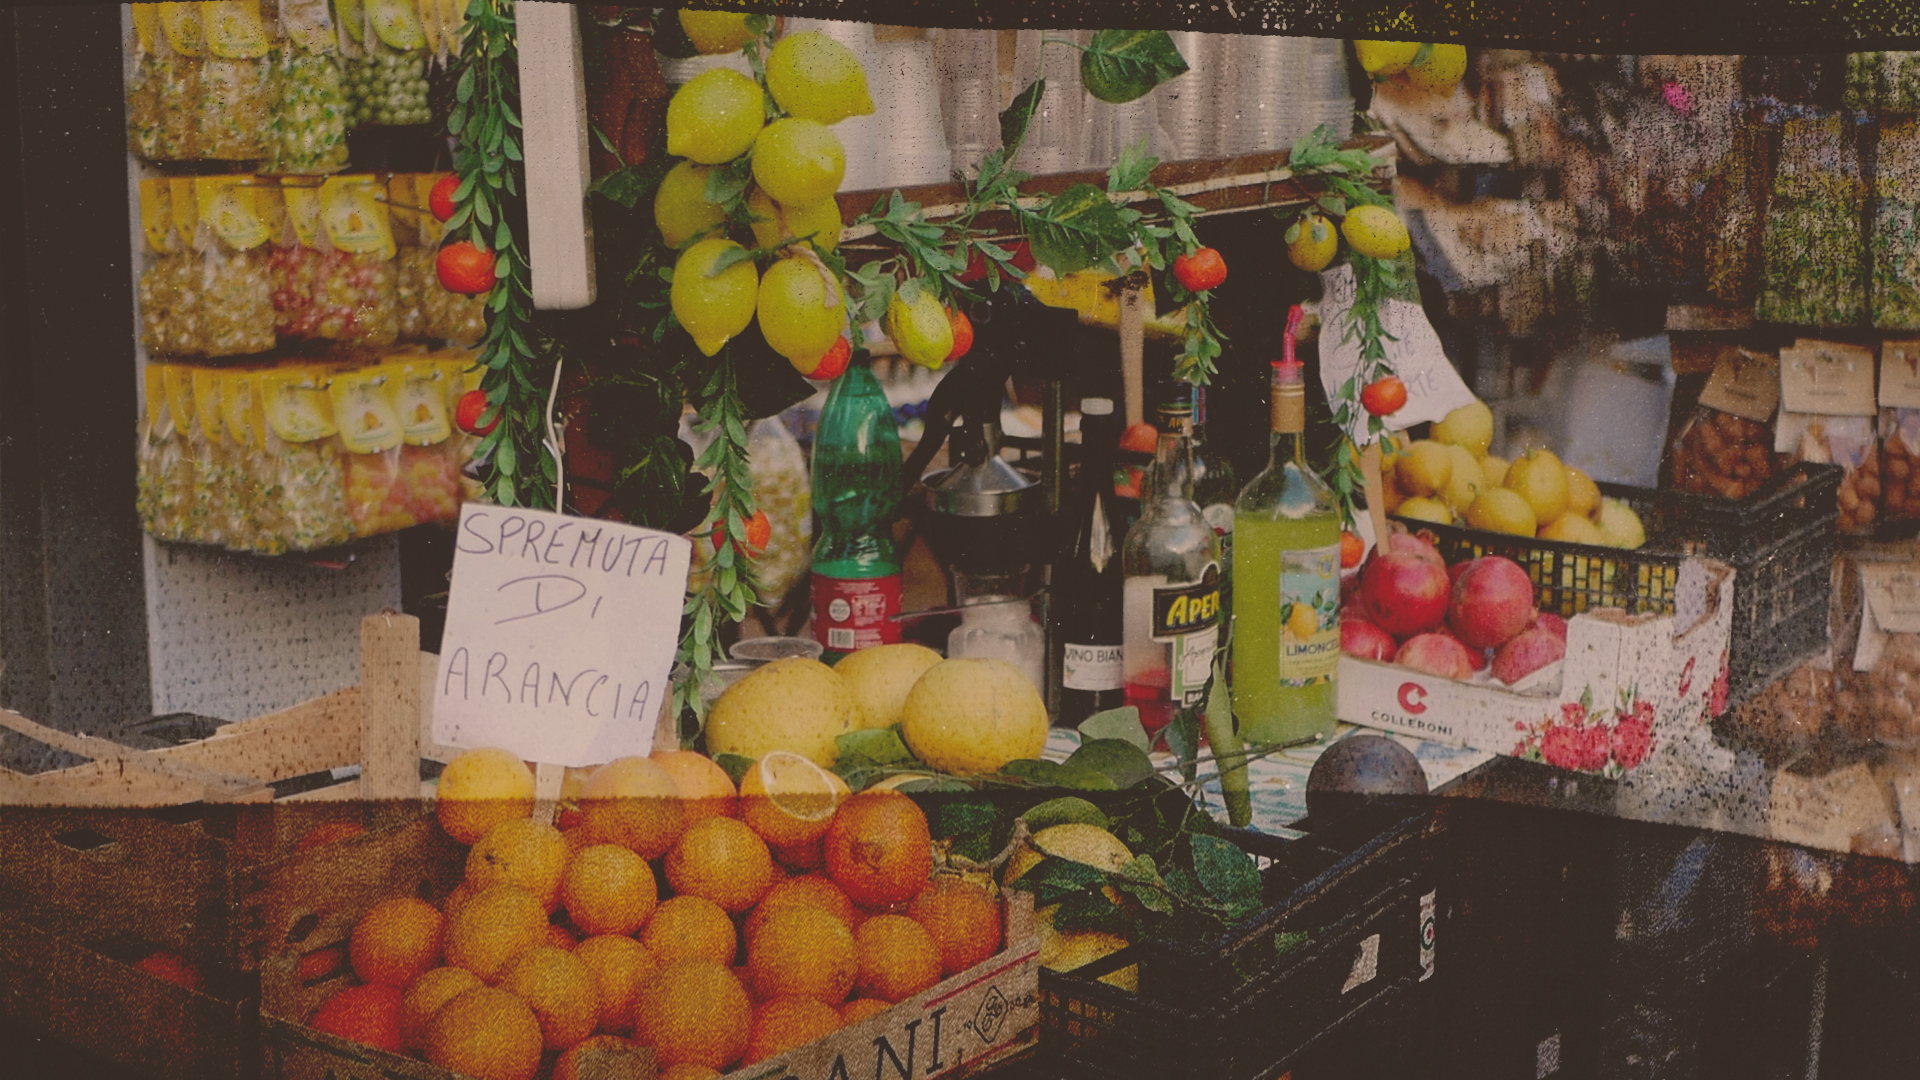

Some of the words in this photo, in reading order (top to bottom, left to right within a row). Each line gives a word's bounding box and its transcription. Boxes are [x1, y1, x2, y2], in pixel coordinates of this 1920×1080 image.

[457, 512, 669, 577] SPREMUTA
[494, 574, 603, 625] DI
[1064, 648, 1093, 664] VINO
[444, 647, 650, 722] ARANCIA
[1371, 710, 1453, 736] COLLERONI
